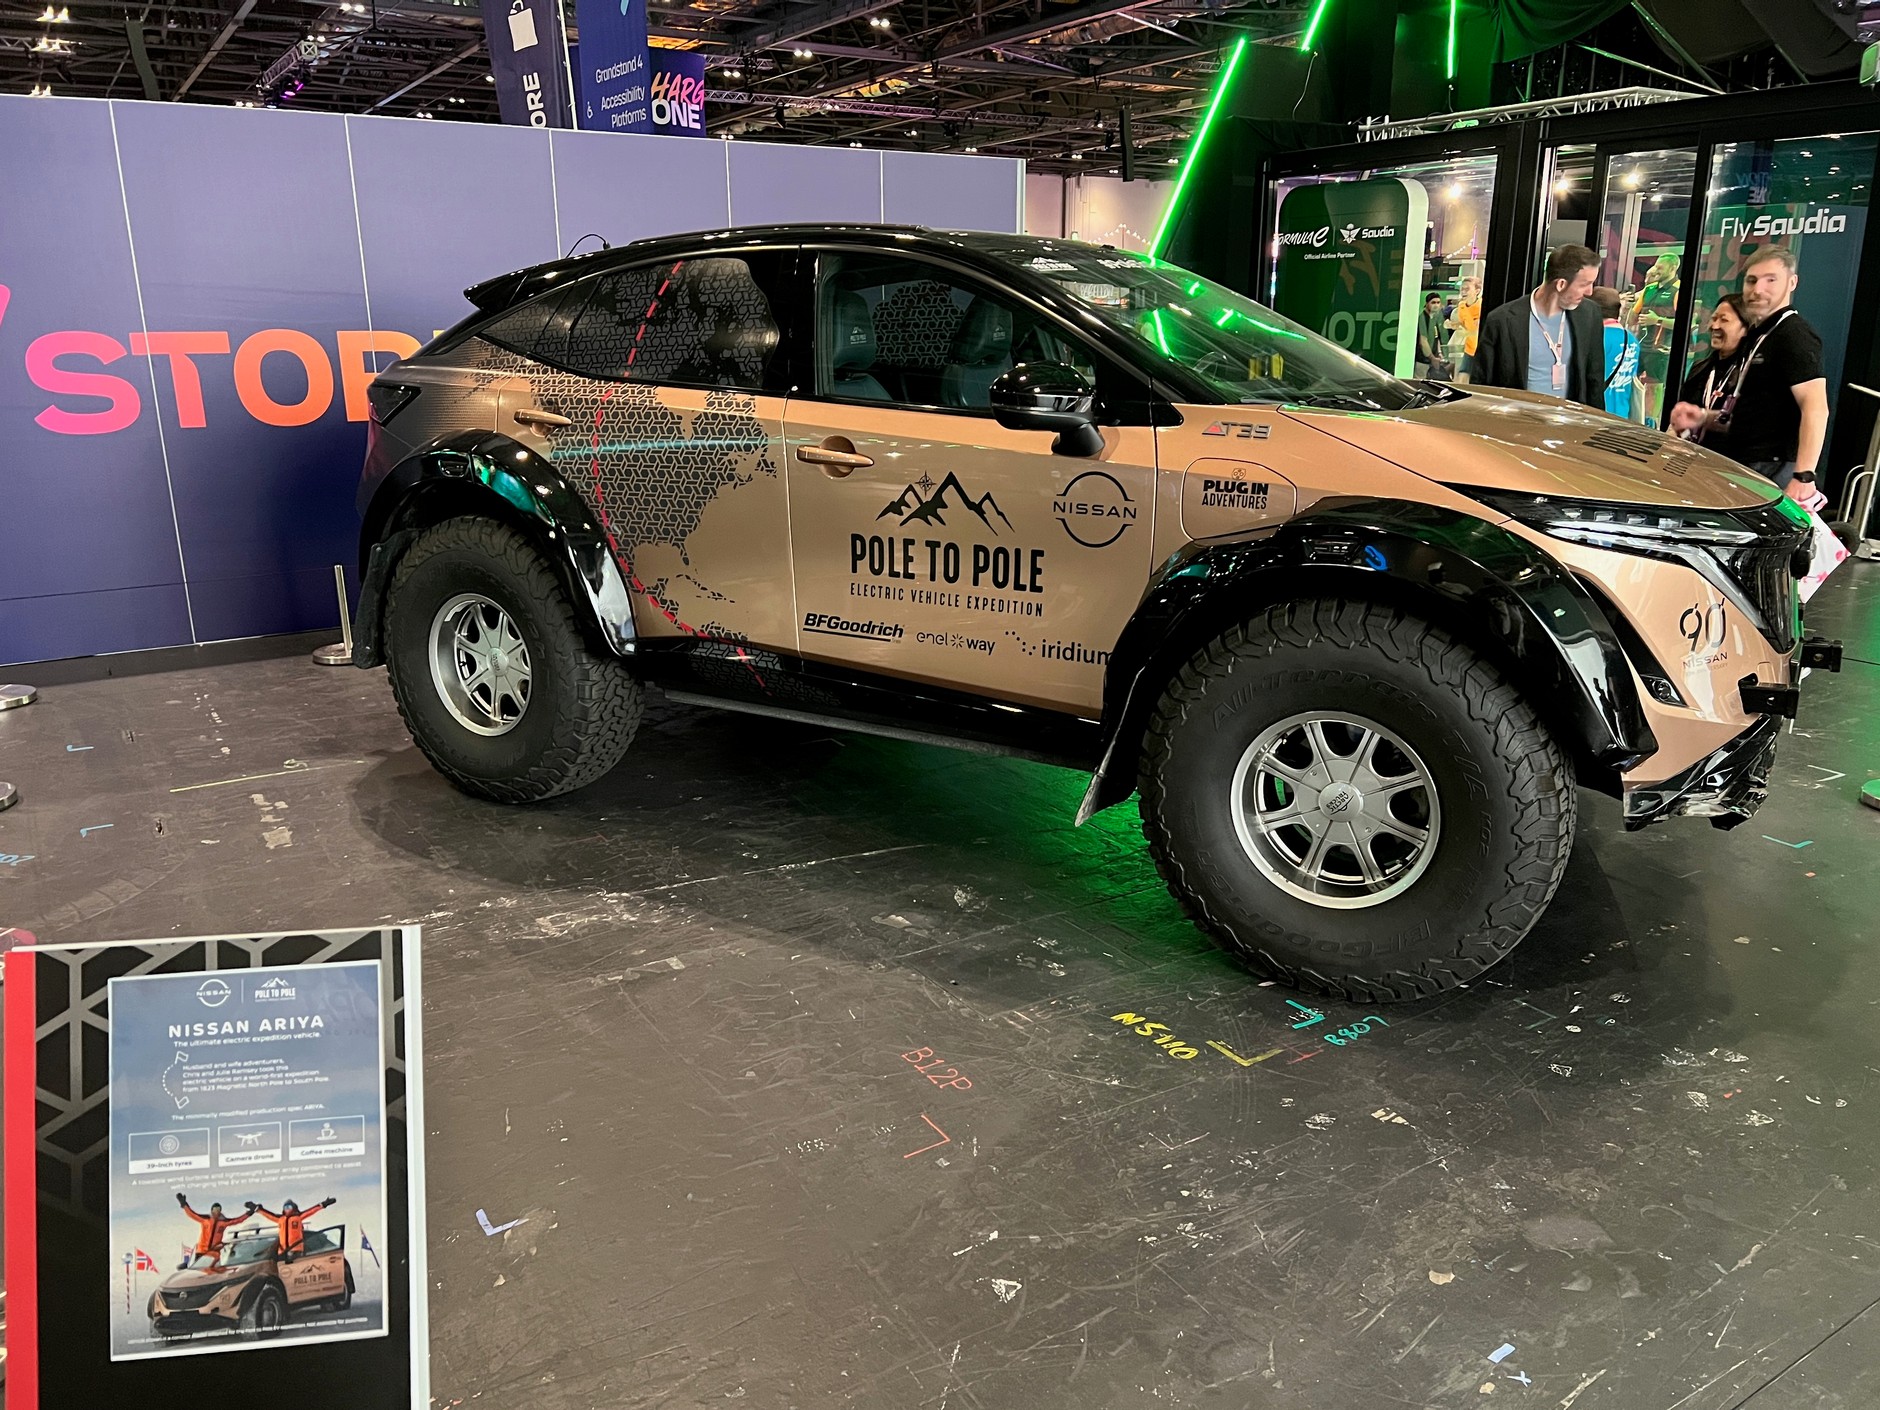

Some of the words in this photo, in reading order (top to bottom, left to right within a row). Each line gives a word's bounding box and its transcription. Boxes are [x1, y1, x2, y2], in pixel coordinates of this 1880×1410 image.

[595, 58, 636, 84] Grandstand
[637, 55, 644, 69] 4
[522, 72, 546, 128] ORE
[601, 85, 645, 111] Accessibility
[611, 107, 647, 128] Platforms
[651, 98, 701, 129] ONE
[1362, 225, 1395, 239] Saudia
[1203, 480, 1249, 494] PLUG
[1250, 482, 1269, 495] IN
[1053, 501, 1137, 519] NISSAN
[1201, 493, 1267, 509] ADVENTURES
[850, 533, 916, 580] POLE
[925, 541, 961, 584] TO
[972, 544, 1045, 593] POLE
[850, 582, 905, 601] ELECTRIC
[911, 589, 960, 608] VEHICLE
[967, 595, 1044, 617] EXPEDITION
[804, 613, 904, 638] BFGoodrich
[1680, 598, 1726, 651] 90
[916, 630, 948, 647] enel
[966, 638, 996, 656] way
[1682, 652, 1728, 669] NISSAN
[196, 988, 231, 997] NISSAN
[168, 1020, 249, 1038] NISSAN
[259, 1015, 324, 1032] ARIYA
[190, 1037, 221, 1046] ultimate
[223, 1036, 250, 1045] electric
[252, 1033, 292, 1043] expedition
[901, 1047, 972, 1089] B12P
[225, 1154, 251, 1162] Camera
[253, 1152, 273, 1160] drone
[300, 1148, 322, 1156] Coffee
[324, 1146, 352, 1154] machine
[174, 1159, 192, 1167] tyres
